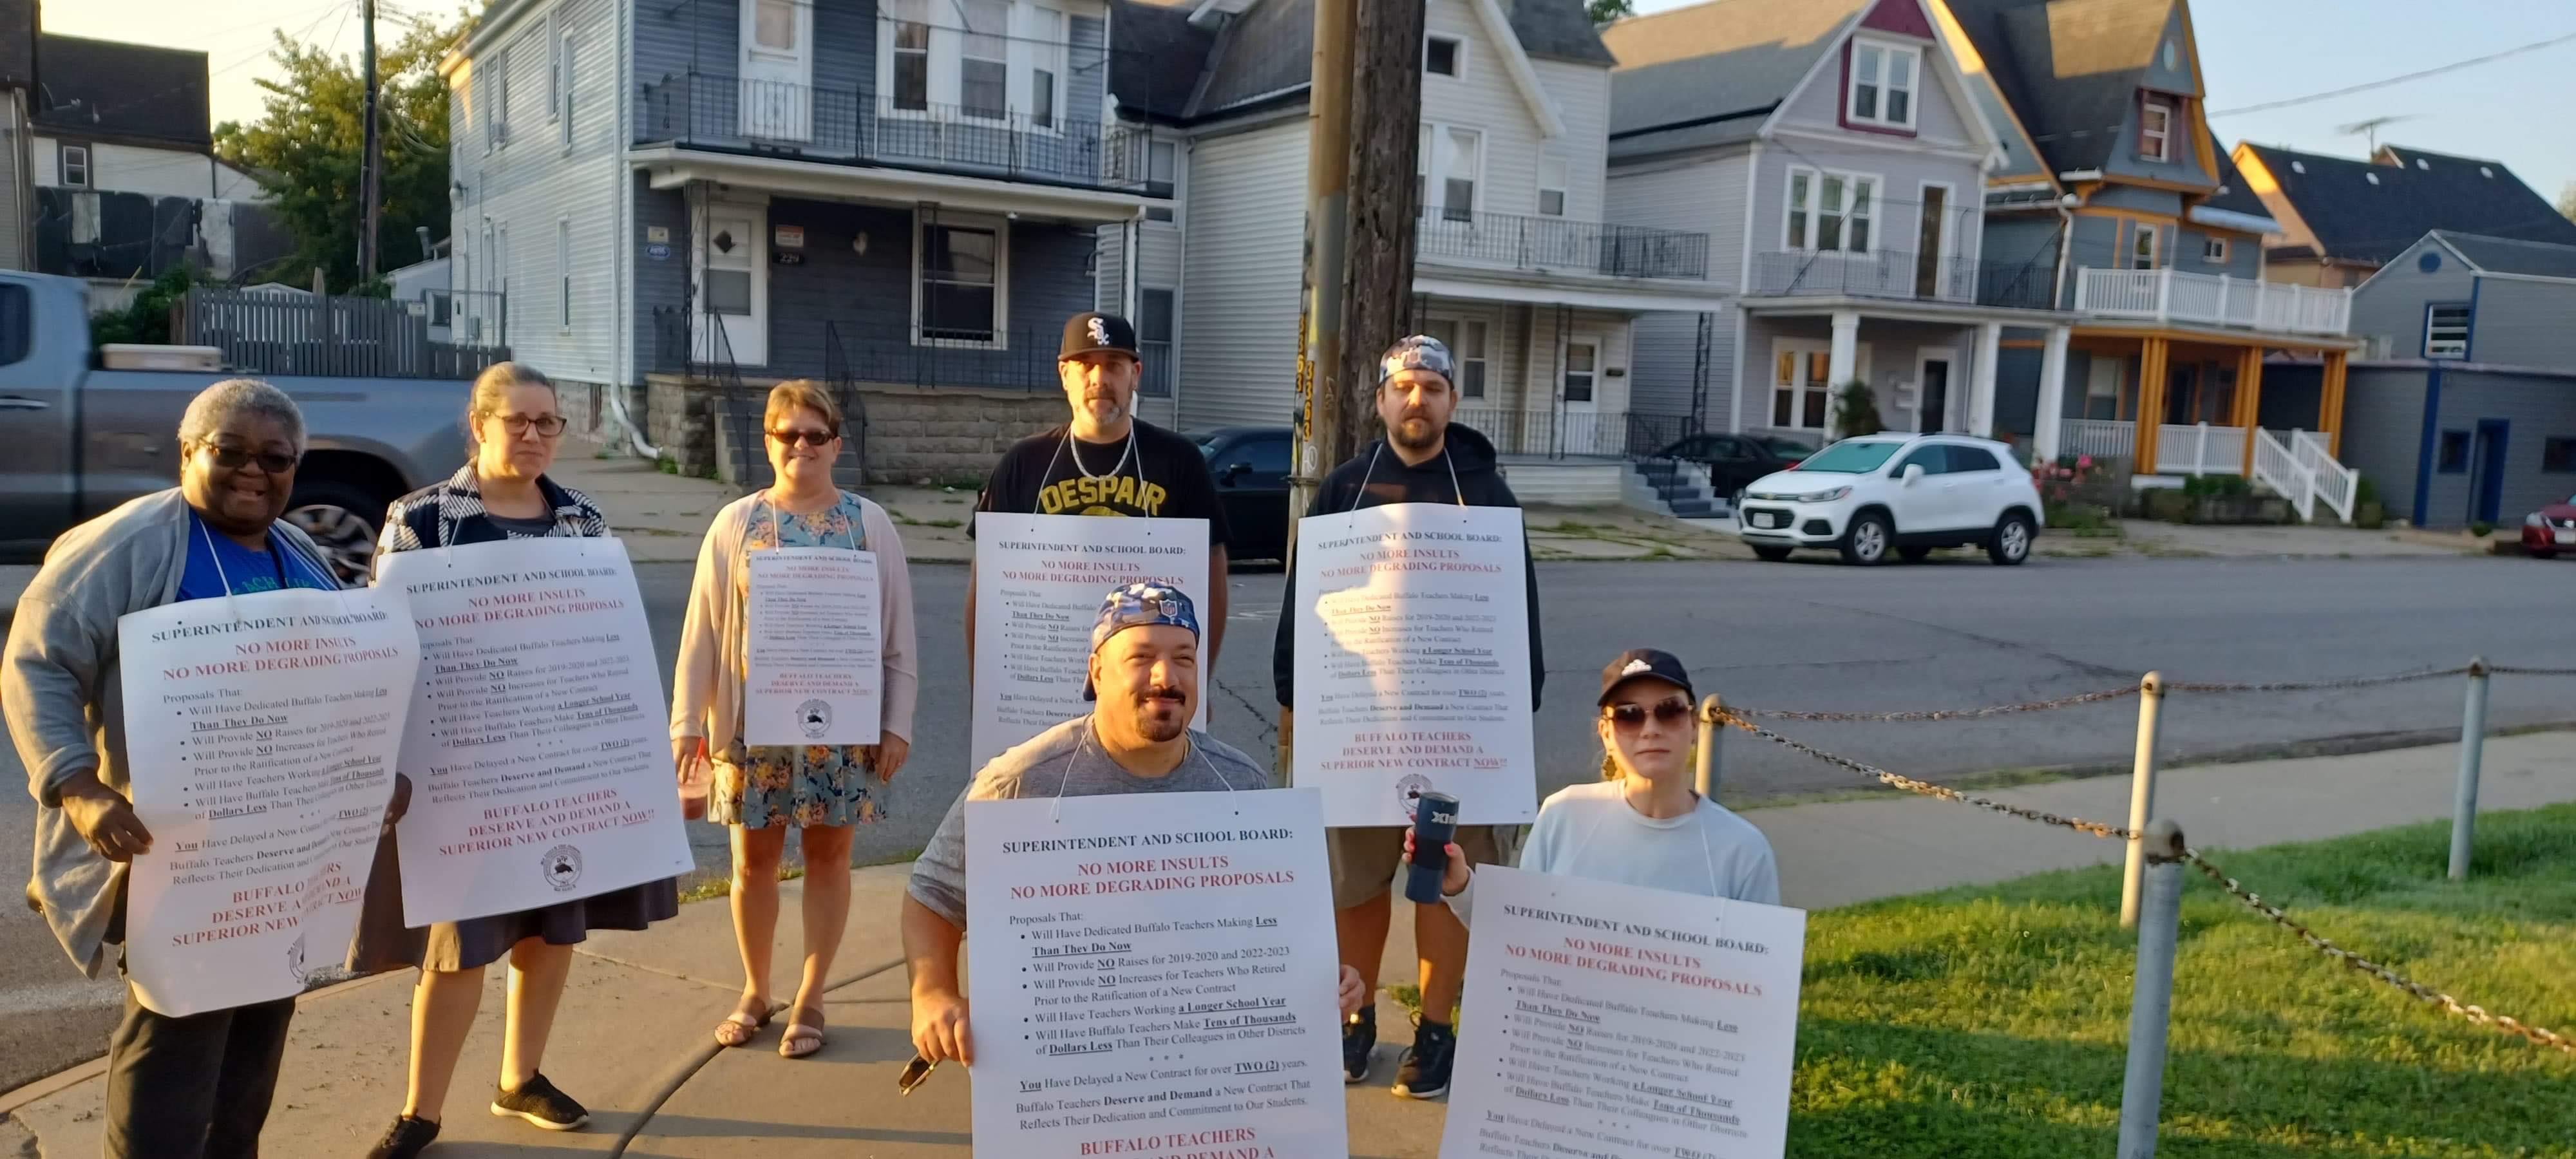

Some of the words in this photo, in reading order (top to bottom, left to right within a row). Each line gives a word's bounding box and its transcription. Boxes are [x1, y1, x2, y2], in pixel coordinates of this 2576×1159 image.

[1087, 317, 1109, 345] Sox
[1303, 361, 1314, 442] 3363
[1041, 475, 1166, 516] DESPAIR
[999, 542, 1078, 551] SUPERINTENDENT
[1318, 533, 1398, 549] SUPERINTENDENT
[1424, 532, 1462, 540] SCHOOL
[1041, 560, 1056, 569] NO
[1057, 561, 1090, 570] MORE
[1093, 562, 1140, 571] INSULTS
[1361, 552, 1375, 561] NO
[1376, 550, 1410, 560] MORE
[1414, 549, 1459, 558] INSULTS
[406, 574, 518, 593] SUPERINTENDENT
[523, 570, 546, 581] AND
[548, 568, 587, 578] SCHOOL
[587, 568, 616, 576] BOARD:
[1019, 572, 1047, 580] MORE
[1050, 574, 1115, 583] DEGRADING
[1337, 565, 1367, 576] MORE
[1369, 561, 1437, 572] DEGRADING
[1439, 562, 1501, 572] PROPOSALS
[468, 597, 489, 607] NO
[493, 593, 535, 605] MORE
[539, 589, 585, 601] INSULTS
[414, 619, 433, 630] NO
[438, 612, 480, 626] MORE
[484, 605, 565, 621] DEGRADING
[568, 600, 624, 612] PROPOSALS
[152, 617, 293, 641] SUPERINTENDENT
[236, 643, 261, 655] NO
[266, 639, 310, 653] MORE
[163, 667, 189, 679] NO
[195, 661, 250, 675] MORE
[255, 654, 341, 670] DEGRADING
[1003, 836, 1137, 853] SUPERINTENDENT
[1142, 834, 1171, 845] AND
[1175, 831, 1235, 843] SCHOOL
[1239, 829, 1293, 840] BOARD:
[1078, 863, 1101, 876] NO
[1106, 860, 1155, 873] MORE
[1161, 856, 1228, 870] INSULTS
[232, 881, 304, 903] BUFFALO
[1010, 886, 1034, 899] NO
[1040, 882, 1090, 896] MORE
[1095, 876, 1195, 893] DEGRADING
[1200, 871, 1293, 887] PROPOSALS
[212, 901, 286, 923] DESERVE
[1009, 913, 1056, 926] Proposals
[1057, 912, 1083, 921] That:
[172, 923, 259, 946] SUPERIOR
[1031, 929, 1052, 939] Will
[1056, 928, 1083, 938] Have
[1083, 924, 1131, 936] Dedicated
[1134, 922, 1170, 932] Buffalo
[1171, 920, 1214, 930] Teachers
[1217, 917, 1253, 928] Making
[1255, 916, 1276, 927] Less
[1504, 905, 1618, 930] SUPERINTENDENT
[1625, 925, 1651, 936] AND
[1654, 928, 1709, 945] SCHOOL
[1715, 938, 1768, 953] BOARD:
[1032, 947, 1059, 958] Than
[1061, 944, 1089, 956] They
[1091, 943, 1105, 954] Do
[1108, 942, 1130, 953] Now
[1032, 962, 1054, 972] Will
[1057, 959, 1094, 971] Provide
[1097, 958, 1117, 970] NO
[1116, 957, 1148, 966] Raises
[1151, 955, 1165, 964] for
[1168, 951, 1218, 963] 2019-2020
[1220, 949, 1238, 959] and
[1240, 946, 1289, 958] 2022-2023
[1564, 937, 1585, 950] NO
[1589, 941, 1633, 957] MORE
[1638, 949, 1700, 968] INSULTS
[1033, 979, 1055, 989] Will
[1057, 976, 1095, 988] Provide
[1097, 974, 1117, 987] NO
[1119, 974, 1162, 983] Increases
[1165, 970, 1179, 980] for
[1180, 968, 1224, 979] Teachers
[1226, 966, 1249, 975] Who
[1251, 963, 1285, 974] Retired
[1506, 944, 1526, 957] NO
[1530, 948, 1571, 965] MORE
[1577, 956, 1667, 980] DEGRADING
[1671, 972, 1761, 995] PROPOSALS
[1032, 995, 1059, 1006] Prior
[1061, 995, 1071, 1004] to
[1073, 993, 1088, 1003] the
[1091, 990, 1147, 1001] Ratification
[1149, 987, 1160, 997] of
[1170, 986, 1194, 995] New
[1195, 984, 1236, 994] Contract
[1035, 1012, 1056, 1022] Will
[1059, 1012, 1084, 1021] Have
[1088, 1008, 1131, 1019] Teachers
[1133, 1004, 1175, 1015] Working
[1178, 1005, 1184, 1015] a
[1187, 1002, 1223, 1014] Longer
[1226, 997, 1259, 1011] School
[1262, 997, 1285, 1008] Year
[1035, 1030, 1057, 1040] Will
[1059, 1028, 1086, 1039] Have
[1088, 1025, 1125, 1036] Buffalo
[1129, 1023, 1170, 1033] Teachers
[1173, 1021, 1200, 1030] Make
[1204, 1018, 1227, 1028] Tens
[1230, 1015, 1242, 1026] of
[1244, 1013, 1296, 1024] Thousands
[1036, 1045, 1048, 1055] of
[1049, 1042, 1089, 1056] Dollars
[1090, 1041, 1115, 1053] Less
[1117, 1039, 1140, 1048] Than
[1144, 1036, 1170, 1046] Their
[1171, 1030, 1224, 1044] Colleagues
[1226, 1027, 1236, 1040] in
[1237, 1024, 1264, 1039] Other
[1267, 1022, 1305, 1036] Districts
[1019, 1080, 1042, 1092] You
[1045, 1078, 1072, 1088] Have
[1073, 1073, 1113, 1086] Delayed
[1124, 1071, 1148, 1081] New
[1150, 1069, 1191, 1079] Contract
[1194, 1066, 1208, 1075] for
[1233, 1061, 1264, 1075] TWO
[1264, 1060, 1280, 1072] (2)
[1280, 1060, 1306, 1071] years.
[1081, 1137, 1160, 1156] BUFFALO
[1166, 1128, 1255, 1147] TEACHERS
